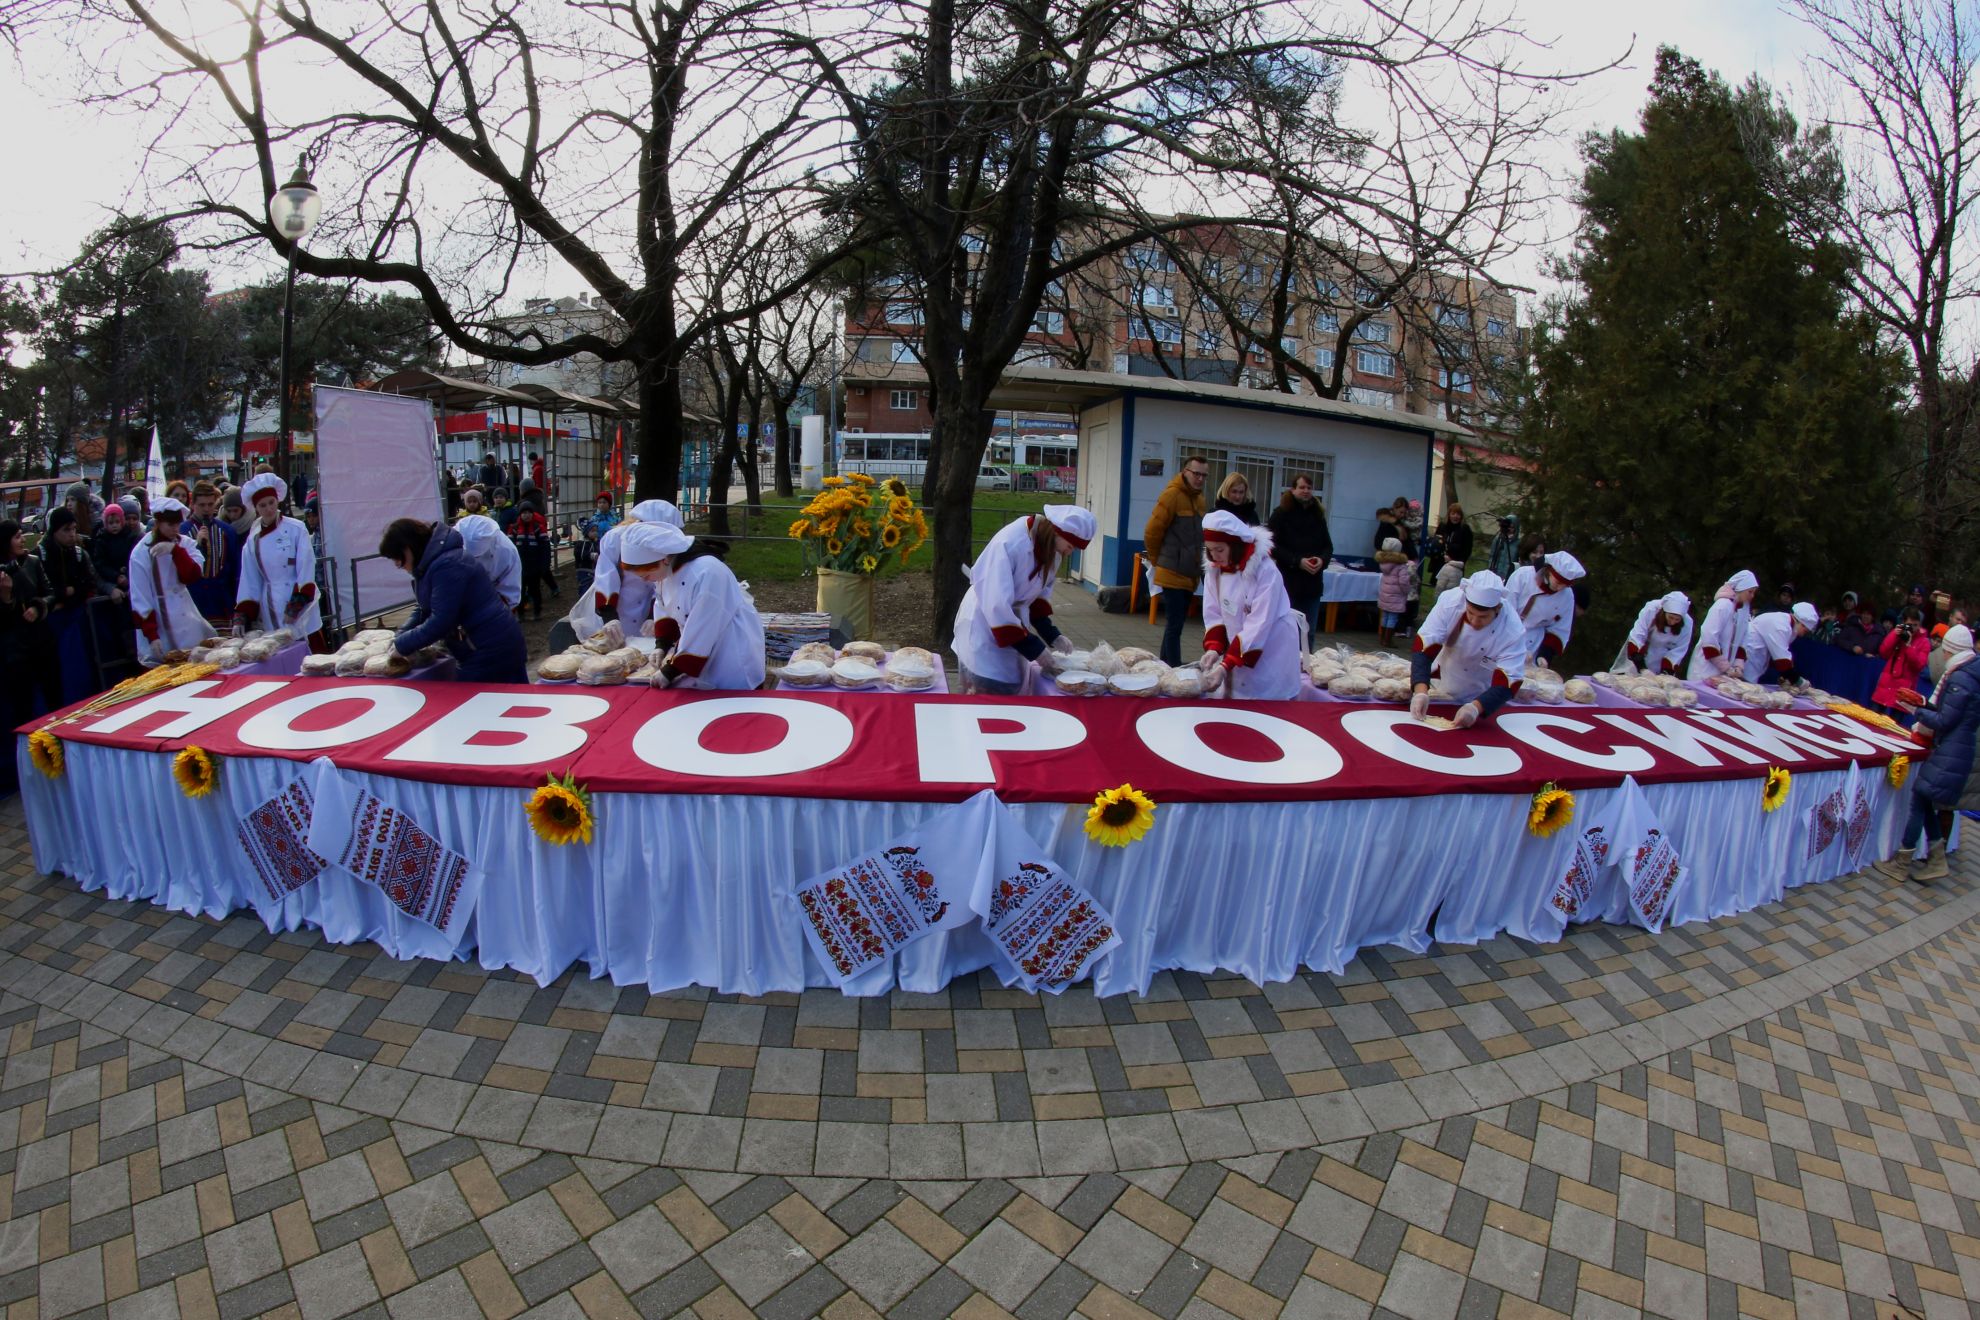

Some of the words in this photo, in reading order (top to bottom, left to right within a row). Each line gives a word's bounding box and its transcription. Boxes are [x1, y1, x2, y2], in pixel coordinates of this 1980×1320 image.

[81, 680, 1926, 785] НОВОРОССИЙСК
[280, 792, 304, 831] ХЛЕБ
[365, 847, 384, 881] ХЛЕБ
[376, 807, 394, 843] СОЛЬ
